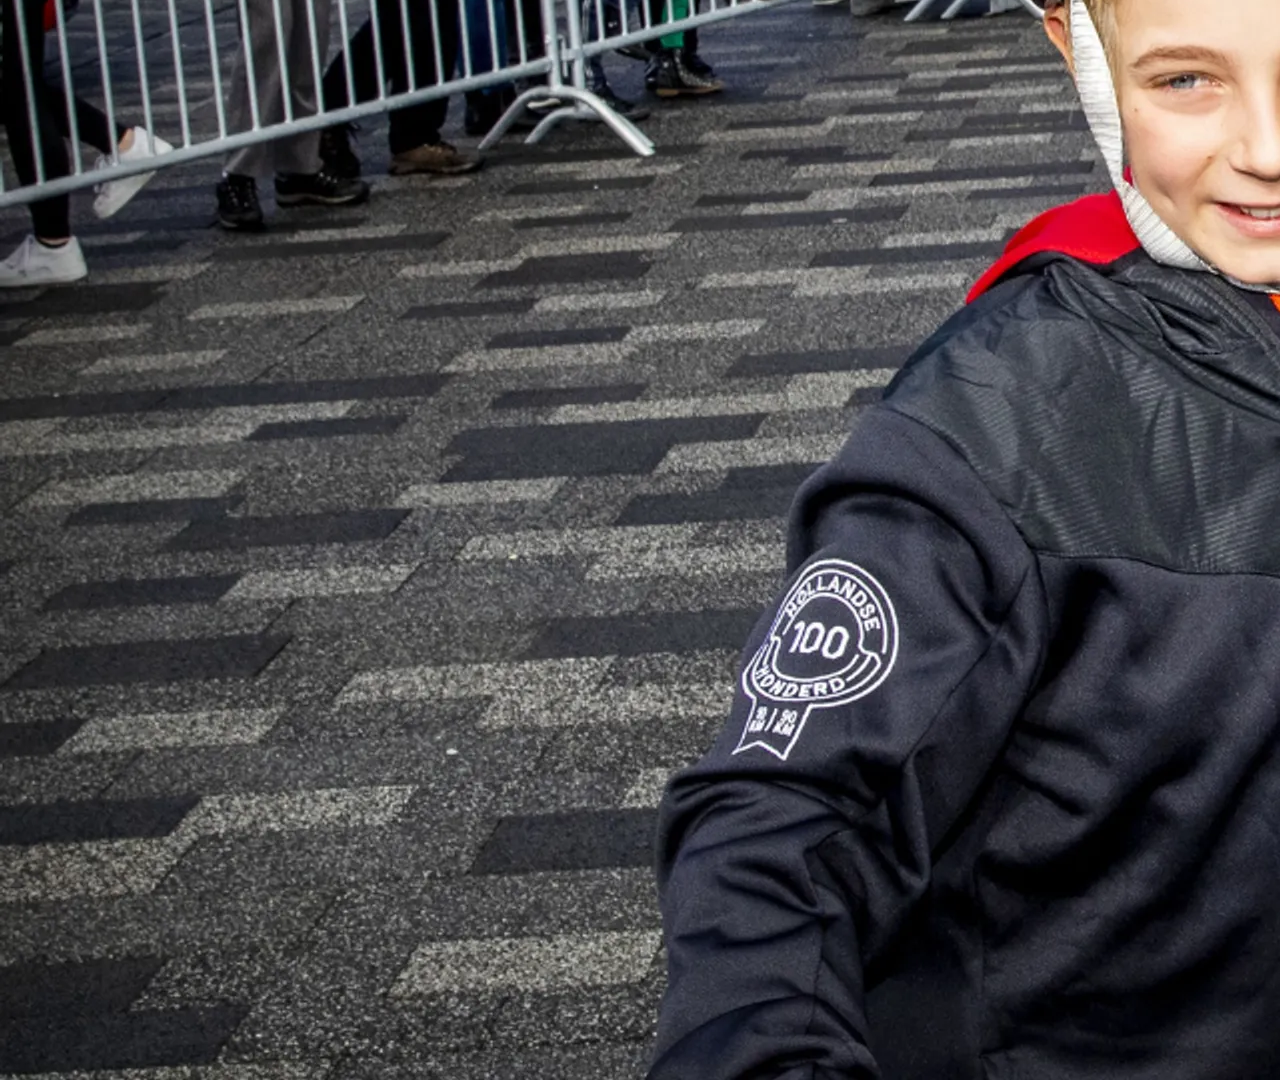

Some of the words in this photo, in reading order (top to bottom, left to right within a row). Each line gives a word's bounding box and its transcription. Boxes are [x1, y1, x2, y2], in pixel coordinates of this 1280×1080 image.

[785, 576, 880, 631] HOLLANDSE
[789, 621, 849, 659] 100
[755, 665, 845, 697] HONDERD
